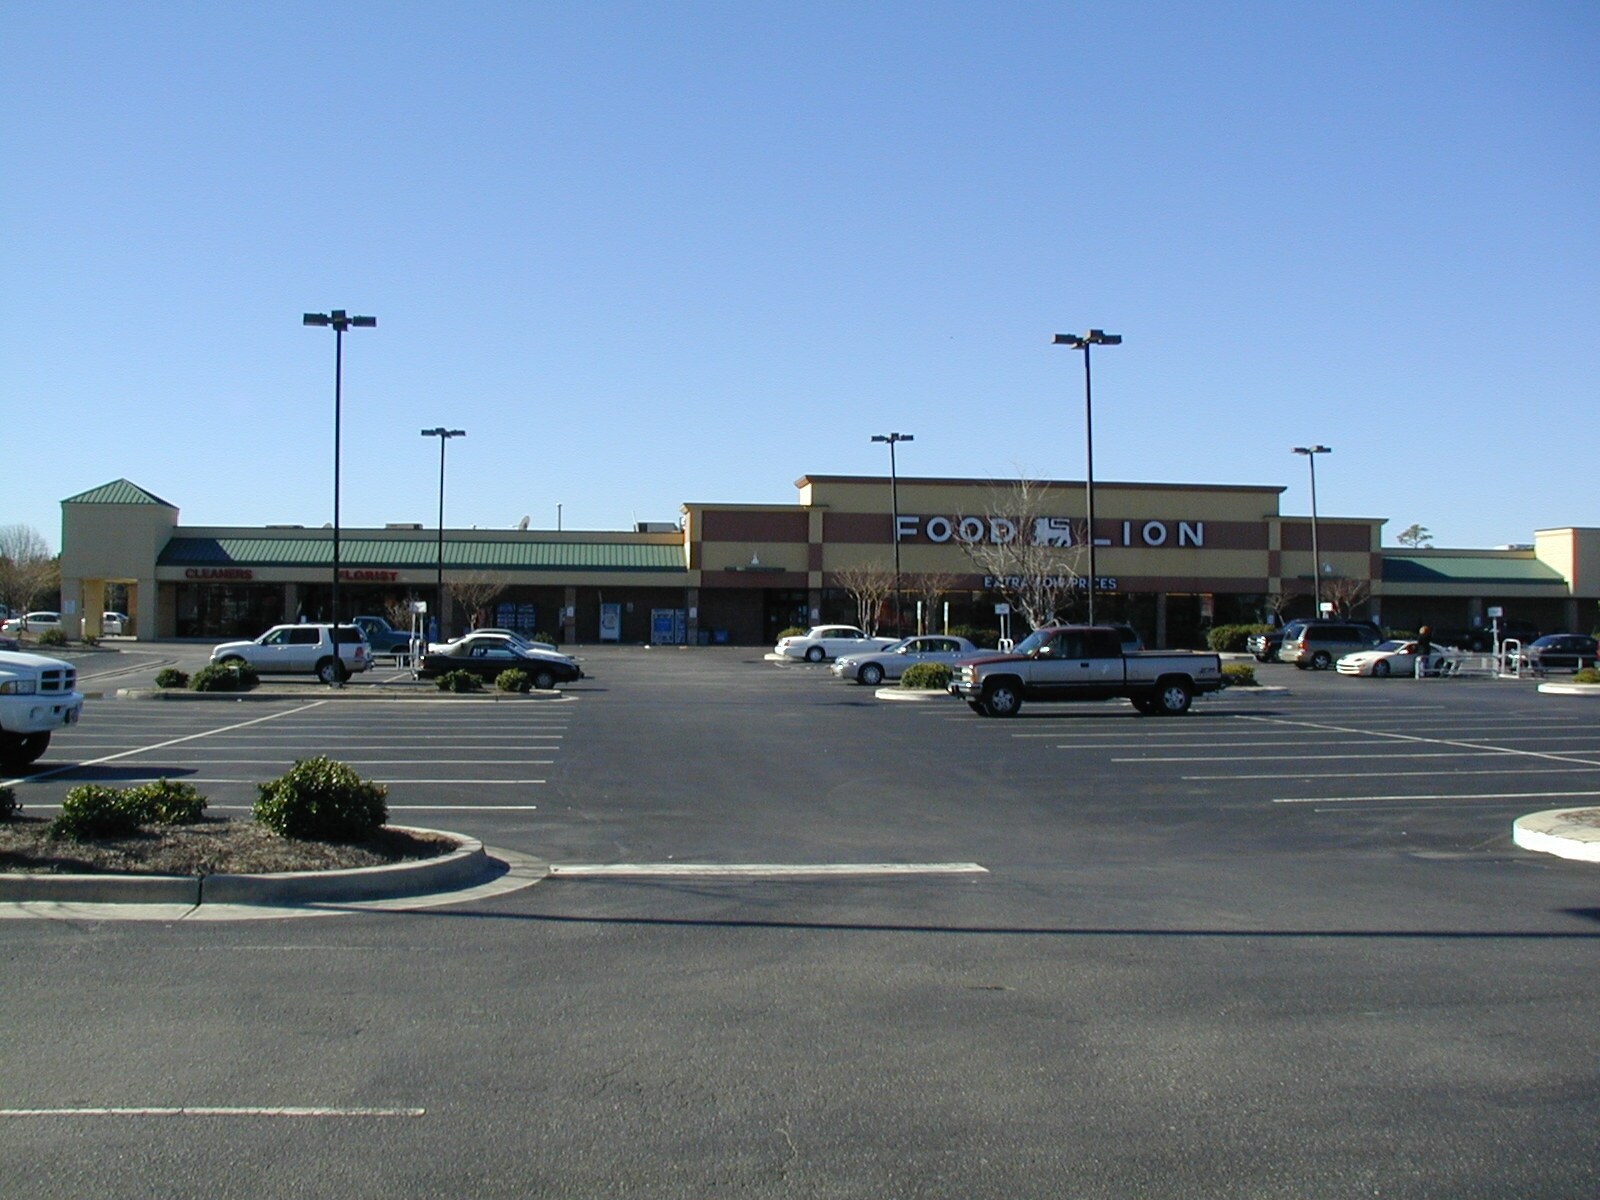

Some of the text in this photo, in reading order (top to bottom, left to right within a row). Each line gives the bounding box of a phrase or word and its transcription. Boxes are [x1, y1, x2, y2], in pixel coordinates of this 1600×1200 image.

[896, 515, 1015, 543] FOOD
[185, 568, 253, 580] CLEANERS
[1070, 577, 1118, 590] PRES
